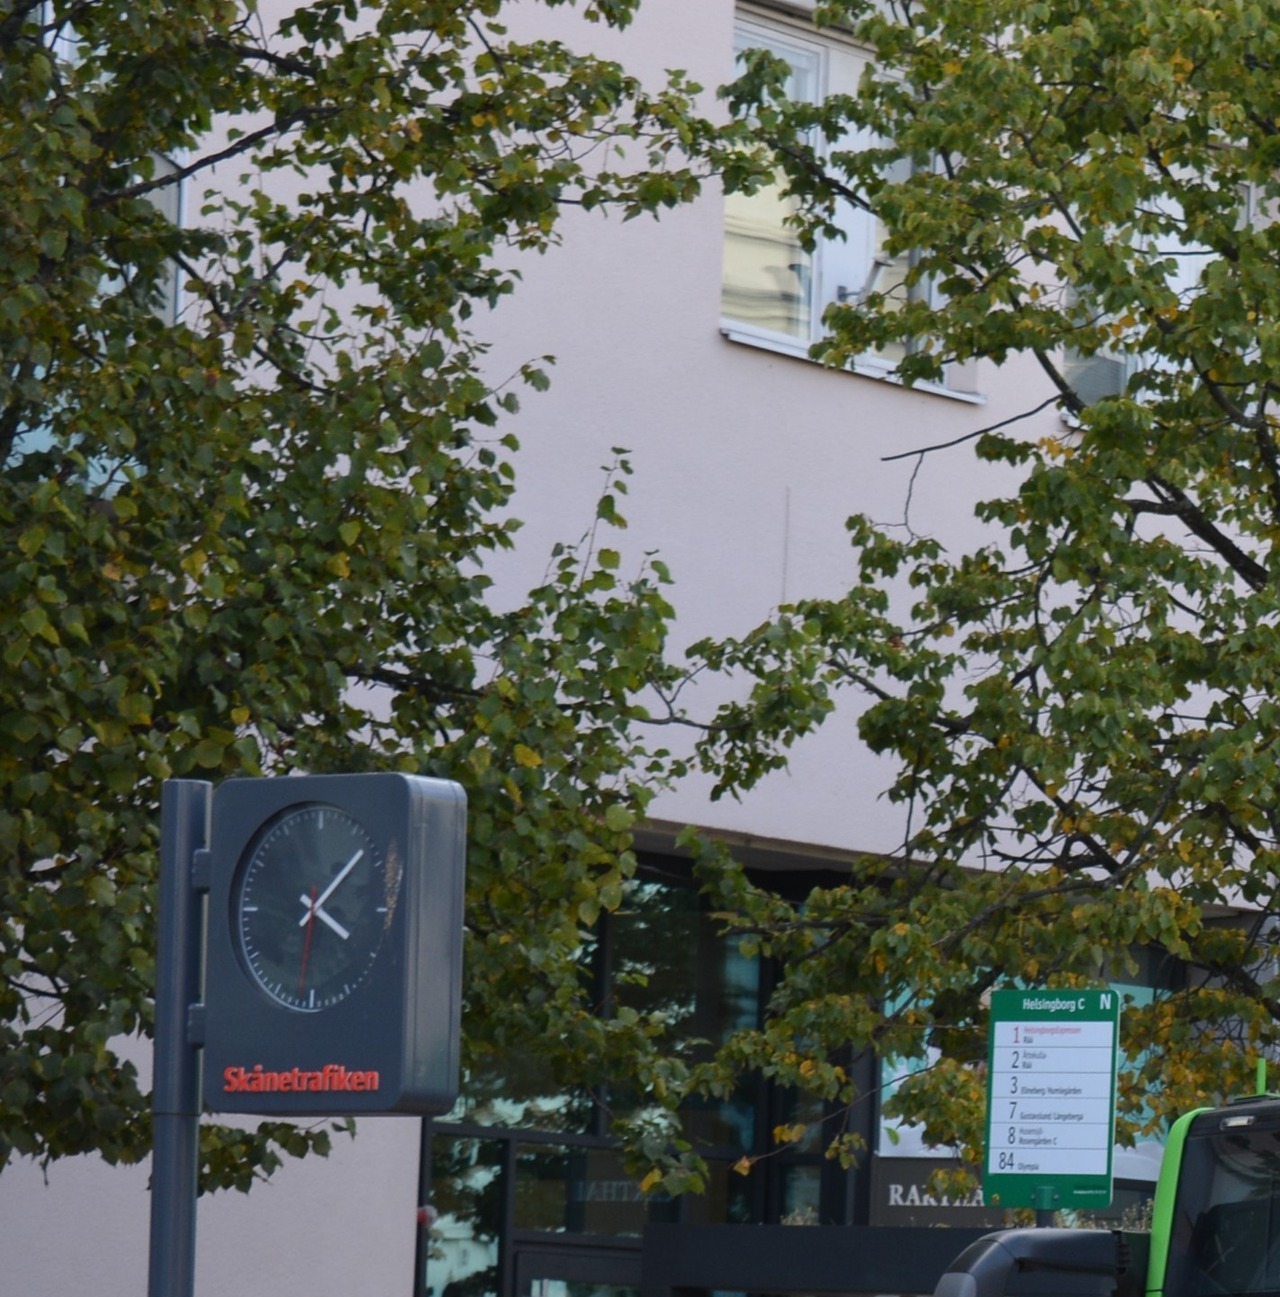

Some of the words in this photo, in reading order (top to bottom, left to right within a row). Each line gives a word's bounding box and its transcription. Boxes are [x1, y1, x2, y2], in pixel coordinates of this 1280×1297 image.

[1023, 998, 1076, 1012] Helsingborg
[1078, 999, 1085, 1009] C
[1100, 994, 1111, 1009] N
[1013, 1027, 1019, 1043] 1
[1011, 1051, 1019, 1069] 2
[224, 1064, 379, 1092] Skånetrafiken
[1010, 1076, 1018, 1094] 3
[1009, 1102, 1017, 1119] 7
[1008, 1126, 1016, 1144] 8
[998, 1152, 1015, 1170] 84
